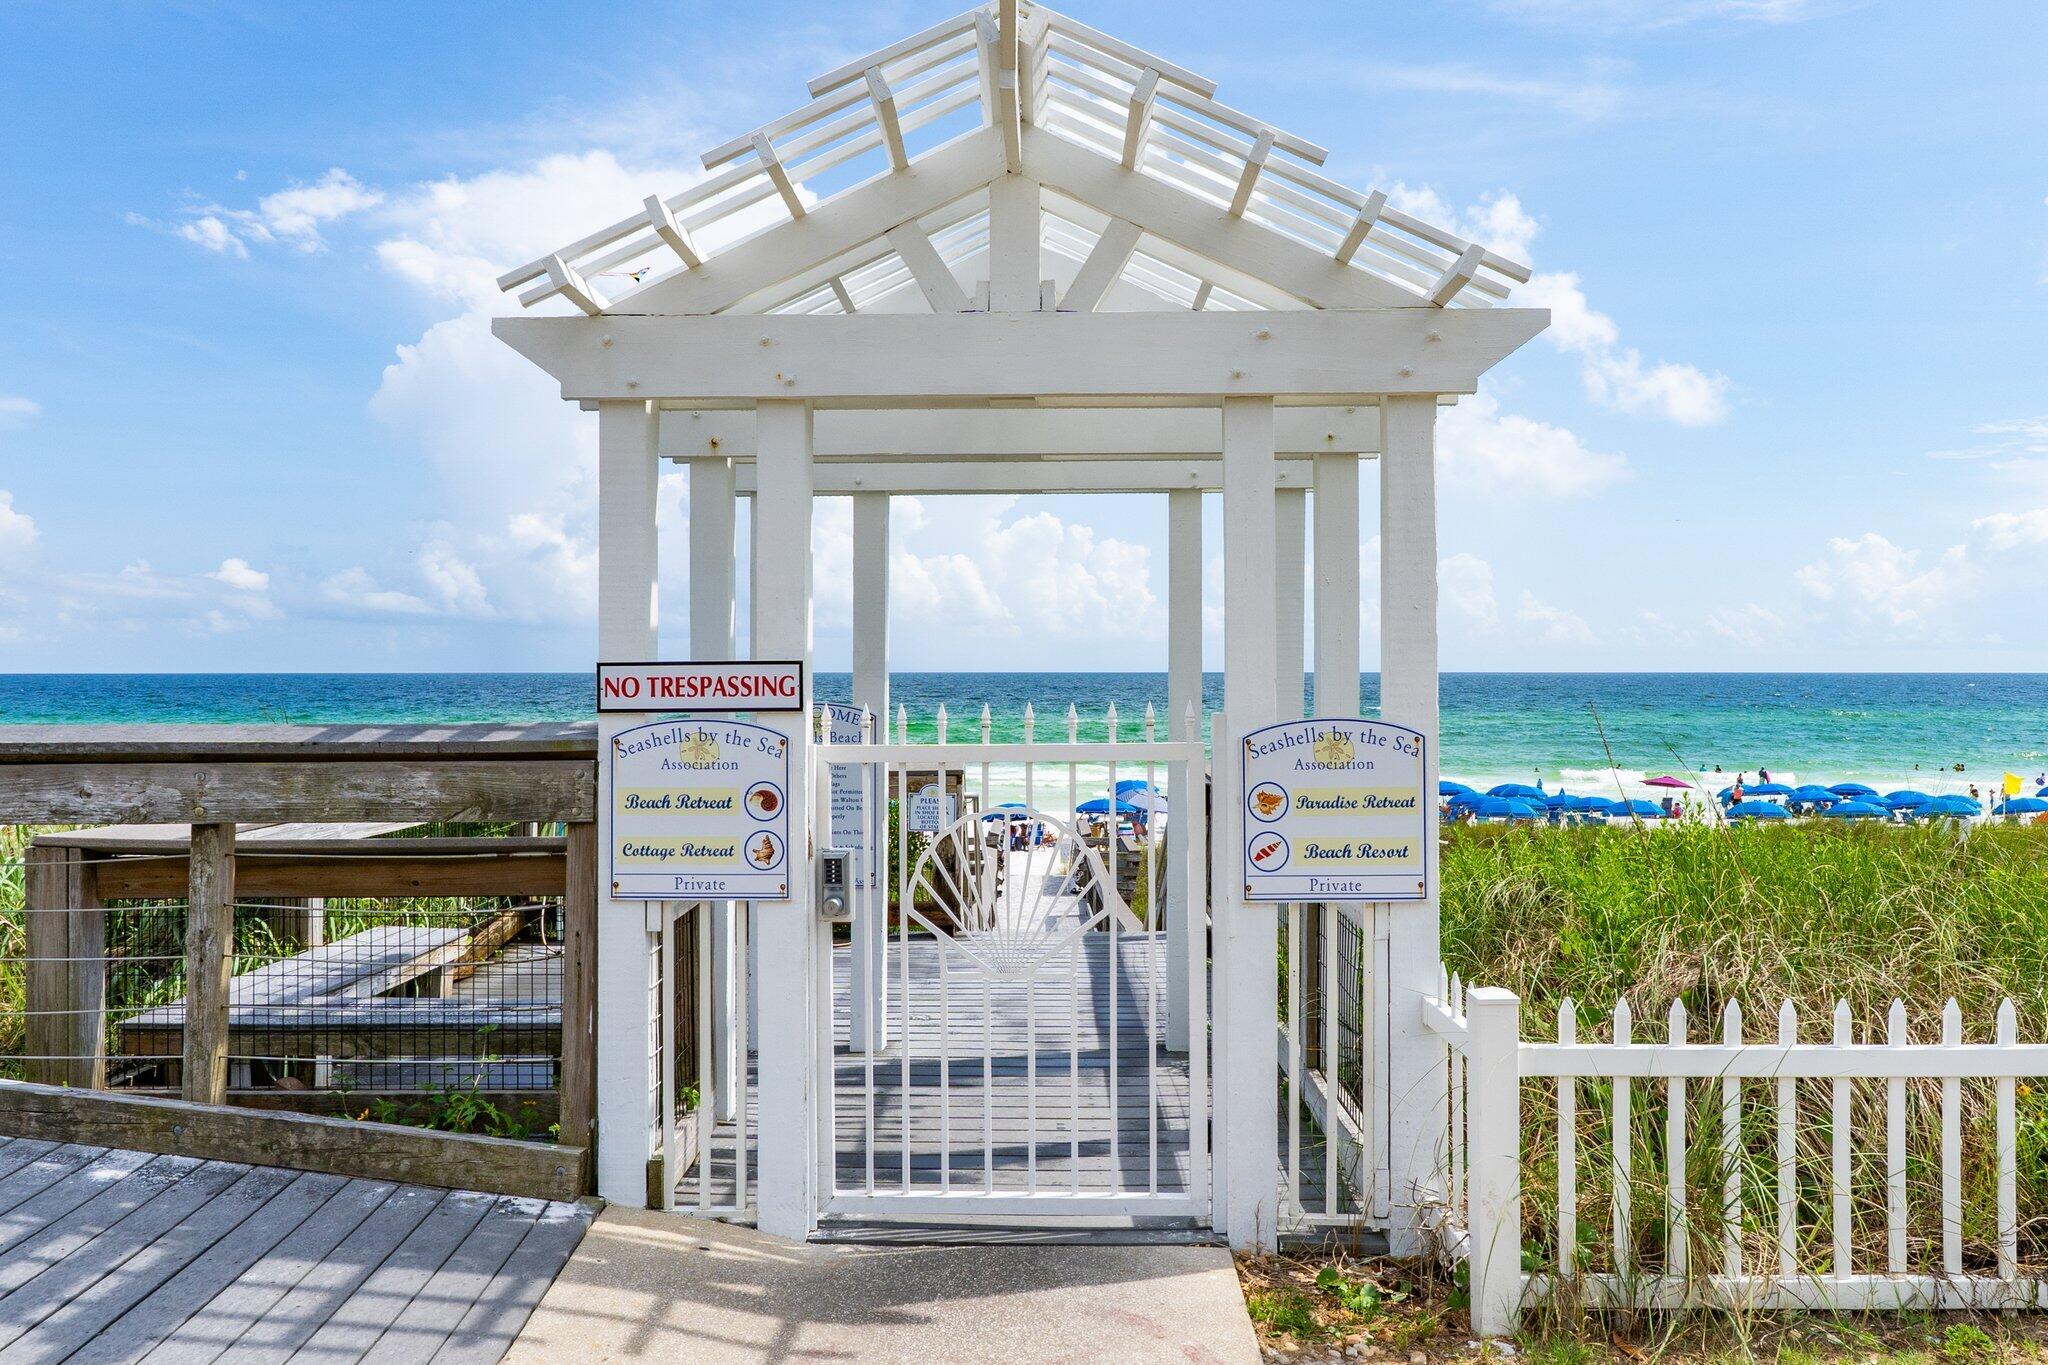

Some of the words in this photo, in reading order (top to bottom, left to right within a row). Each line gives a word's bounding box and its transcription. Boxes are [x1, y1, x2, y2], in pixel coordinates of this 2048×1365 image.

[604, 676, 640, 698] NO
[647, 675, 796, 698] TRESPASSING
[617, 727, 691, 759] Seashells
[698, 726, 718, 747] by
[725, 729, 752, 748] the
[757, 736, 784, 760] Sea
[1248, 726, 1325, 760] Seashells
[1332, 725, 1353, 746] by
[1360, 728, 1387, 747] the
[1392, 735, 1420, 758] Sea
[660, 758, 739, 771] Association
[1294, 757, 1375, 771] Association
[624, 793, 671, 810] Beach
[675, 793, 733, 810] Retreat
[1296, 794, 1359, 810] Paradise
[1363, 794, 1416, 809] Retreat
[622, 843, 675, 861] Cottage
[682, 843, 735, 858] Retreat
[1303, 843, 1352, 859] Beach
[1356, 843, 1409, 859] Resort
[674, 876, 726, 891] Private
[1309, 878, 1362, 892] Private
